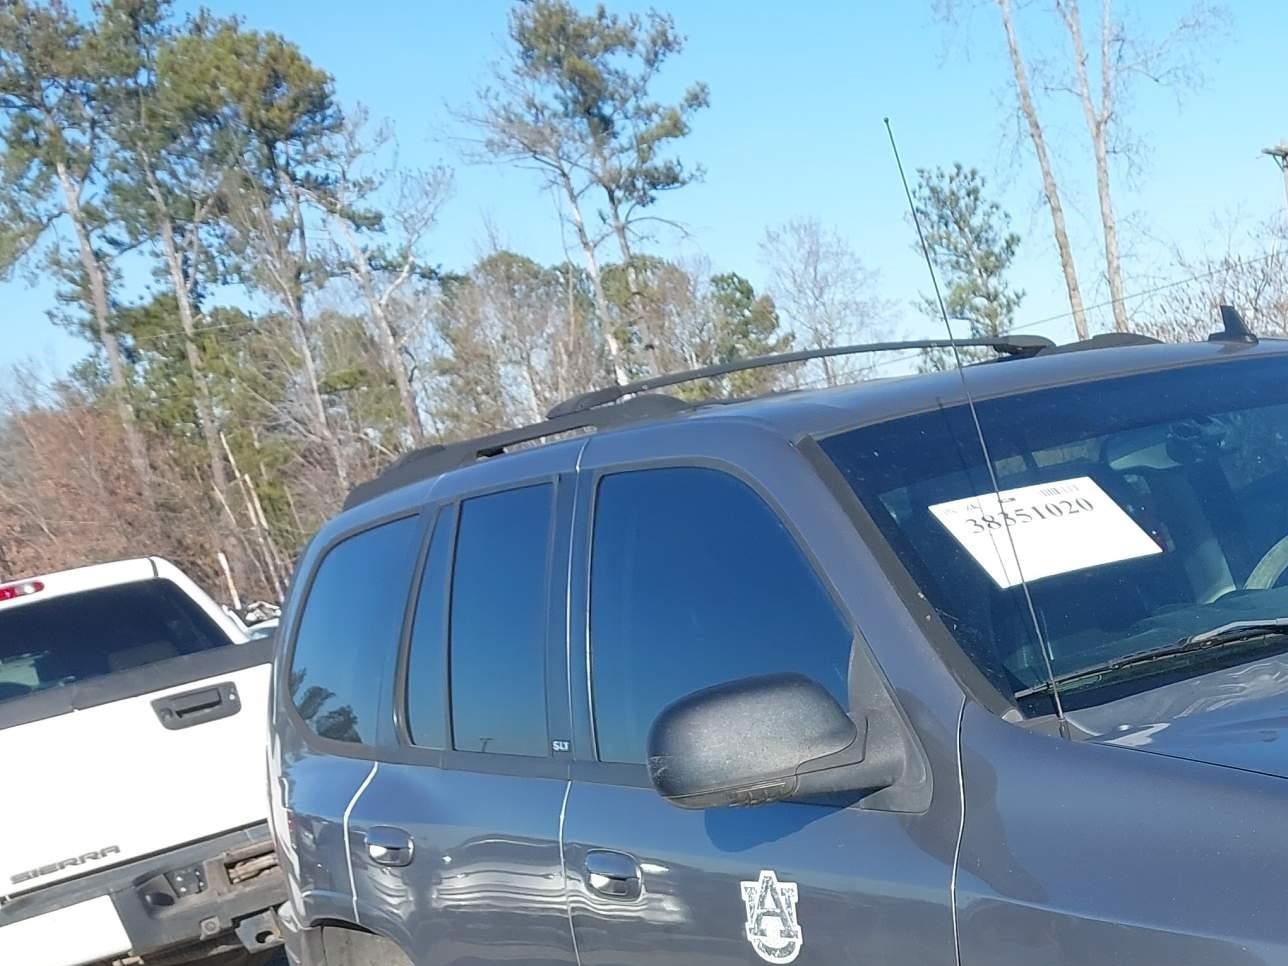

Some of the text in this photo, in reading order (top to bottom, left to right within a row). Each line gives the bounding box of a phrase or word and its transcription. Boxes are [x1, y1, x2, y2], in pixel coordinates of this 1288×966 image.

[966, 496, 1095, 534] 38351020
[552, 741, 570, 751] SLT
[10, 844, 121, 885] SIERRA
